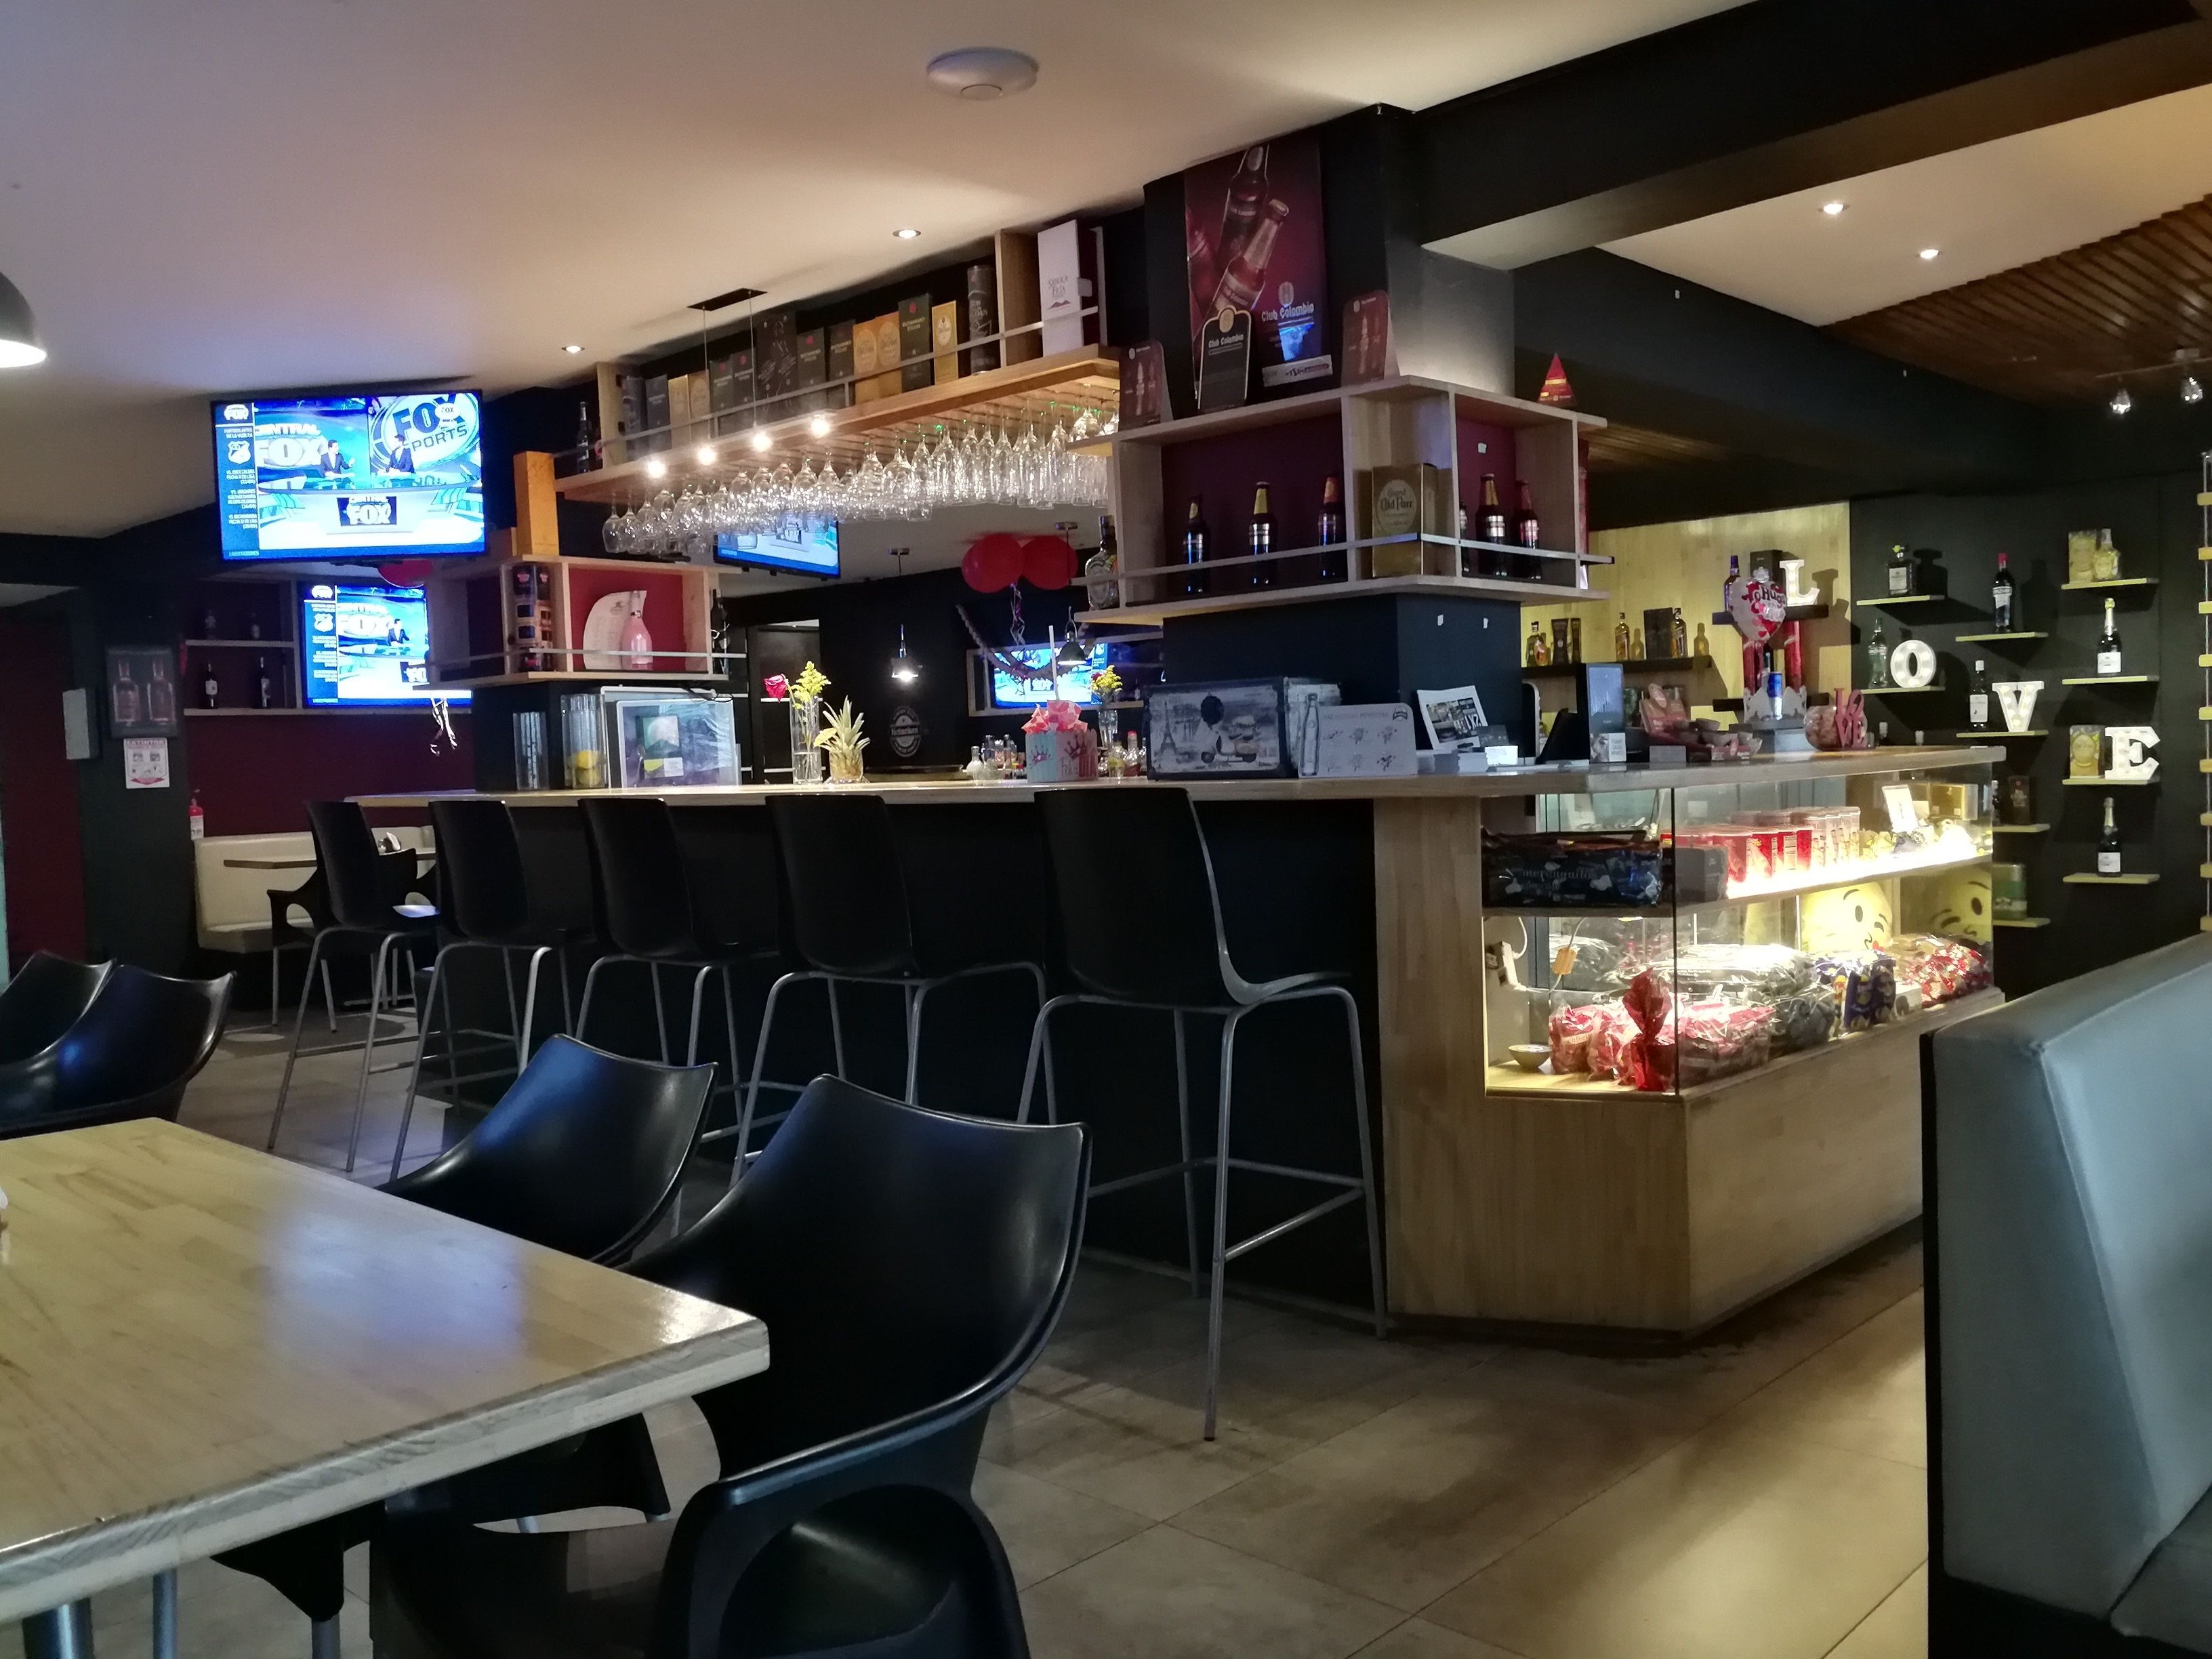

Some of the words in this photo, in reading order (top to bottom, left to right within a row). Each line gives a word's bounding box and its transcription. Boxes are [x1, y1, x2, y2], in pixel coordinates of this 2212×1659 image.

[1262, 310, 1277, 322] Club
[1279, 302, 1315, 319] Colombia
[402, 424, 468, 452] PORTS
